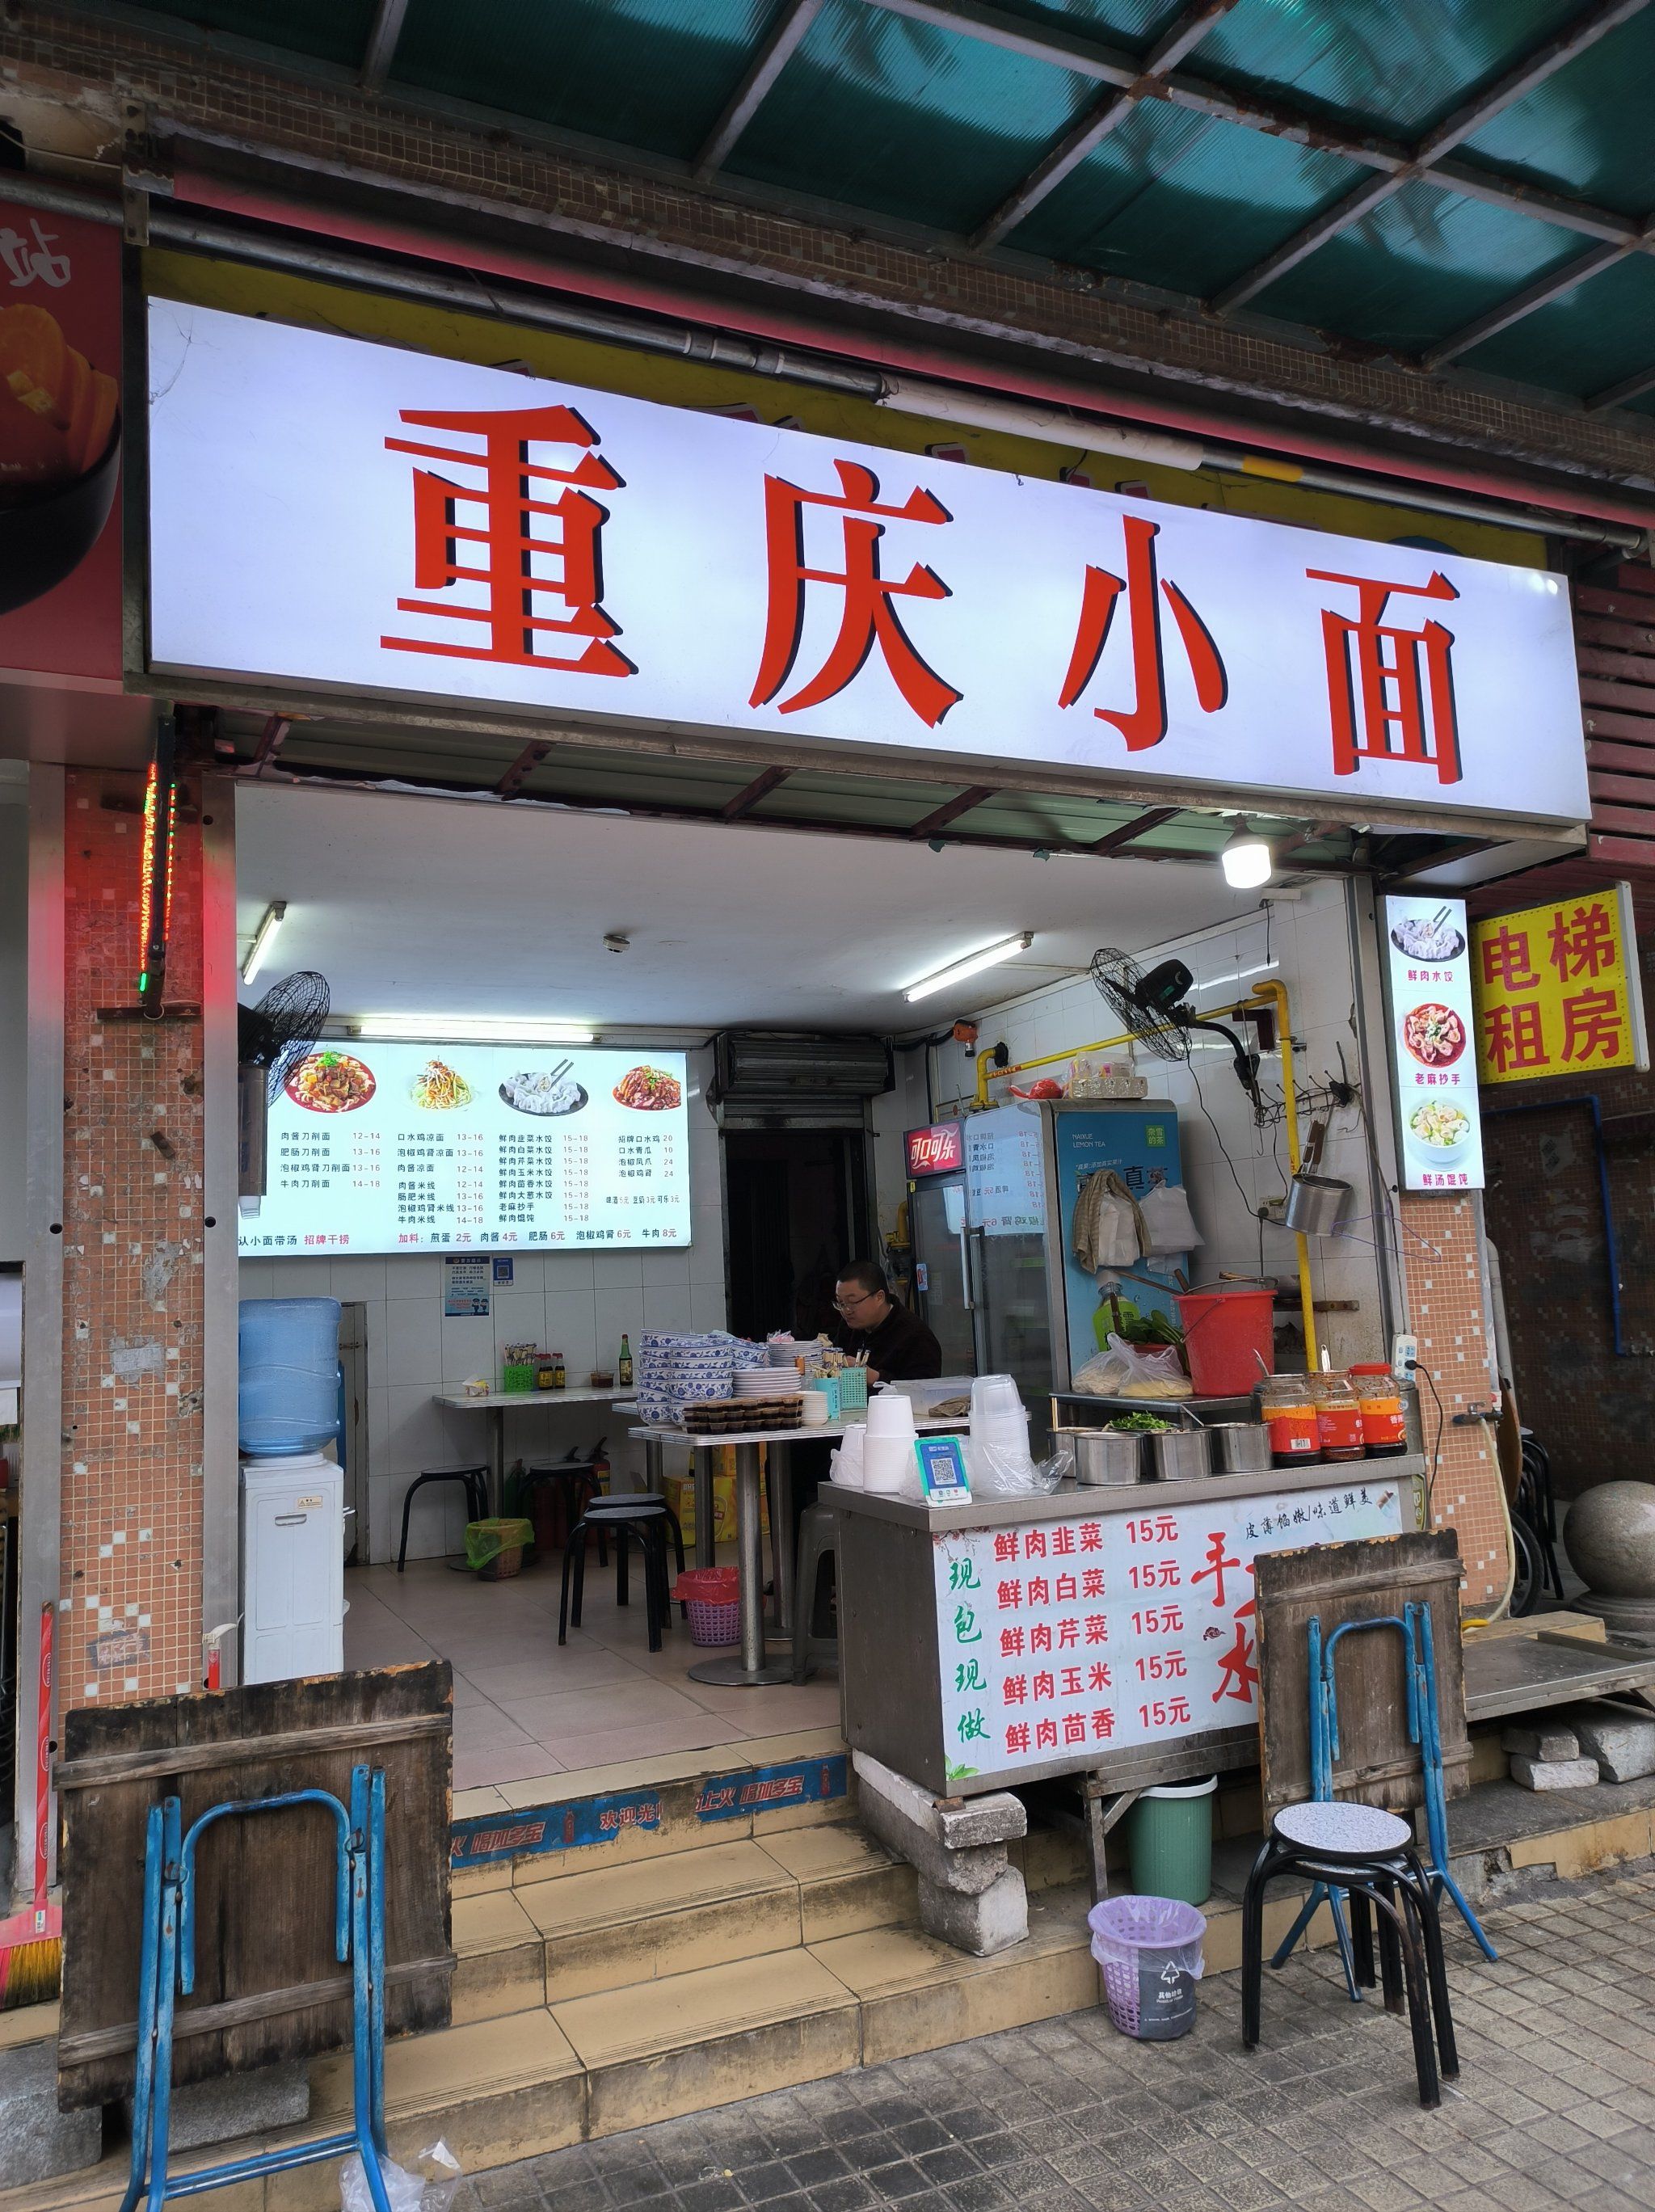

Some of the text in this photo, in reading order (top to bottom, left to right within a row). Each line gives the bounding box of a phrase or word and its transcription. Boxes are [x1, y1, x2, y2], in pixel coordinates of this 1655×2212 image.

[380, 403, 1461, 785] 重庆小面
[1481, 903, 1616, 992] 电梯
[1408, 970, 1454, 983] 鲜肉水饺
[1484, 987, 1622, 1073] 租房
[1415, 1073, 1461, 1085] 老麻抄手
[280, 1132, 330, 1140] 肉酱刀削面
[398, 1133, 444, 1142] 口水鸡凉面
[499, 1135, 552, 1143] 鲜肉韭菜水饺
[618, 1135, 660, 1144] 招牌口水鸡
[1148, 1136, 1164, 1144] 的茶
[499, 1146, 552, 1154] 鲜肉白菜水饺
[911, 1124, 958, 1169] 可口可乐
[280, 1148, 330, 1157] 肥肠刀削面
[398, 1148, 453, 1157] 泡椒鸡肾凉面
[499, 1157, 552, 1165] 鲜肉芹菜水饺
[618, 1158, 652, 1166] 泡椒凤爪
[280, 1164, 350, 1172] 泡椒鸡肾刀削面
[398, 1164, 434, 1172] 肉酱凉面
[499, 1169, 552, 1177] 鲜肉玉米水饺
[1123, 1165, 1144, 1190] 真
[280, 1179, 330, 1188] 牛肉刀削面
[499, 1180, 552, 1188] 鲜肉茴香水饺
[1422, 1173, 1468, 1186] 鲜汤馄饨
[398, 1182, 435, 1190] 肉酱米线
[398, 1193, 436, 1201] 肠肥米线
[499, 1191, 552, 1199] 鲜肉大葱水饺
[657, 1195, 669, 1203] 可乐
[398, 1204, 454, 1212] 泡椒鸡肾米线
[499, 1203, 534, 1211] 老麻抄手
[398, 1216, 436, 1224] 牛肉米线
[499, 1214, 534, 1223] 鲜肉馄饨
[238, 1234, 350, 1246] 认小面带汤 招牌干捞
[431, 1232, 451, 1243] 煎蛋
[456, 1233, 472, 1242] 2元
[480, 1232, 499, 1242] 肉酱
[503, 1232, 518, 1241] 4元
[529, 1231, 548, 1241] 肥肠
[550, 1231, 566, 1241] 6元
[576, 1229, 614, 1240] 泡椒鸡肾
[617, 1229, 631, 1238] 6元
[642, 1228, 659, 1238] 牛肉
[663, 1228, 677, 1237] 8元
[993, 1515, 1179, 1562] 鲜肉韭菜 15元
[996, 1559, 1181, 1610] 鲜肉白菜 15元
[1000, 1604, 1184, 1658] 鲜肉芹菜 15元
[949, 1557, 991, 1743] 现包现做
[1002, 1650, 1187, 1706] 鲜肉玉米 15元
[1005, 1696, 1191, 1755] 鲜肉茴香 15元
[695, 1786, 737, 1813] 上火
[739, 1776, 805, 1805] 喝加多宝
[600, 1802, 663, 1831] 欢迎光
[470, 1822, 546, 1854] 喝加多宝
